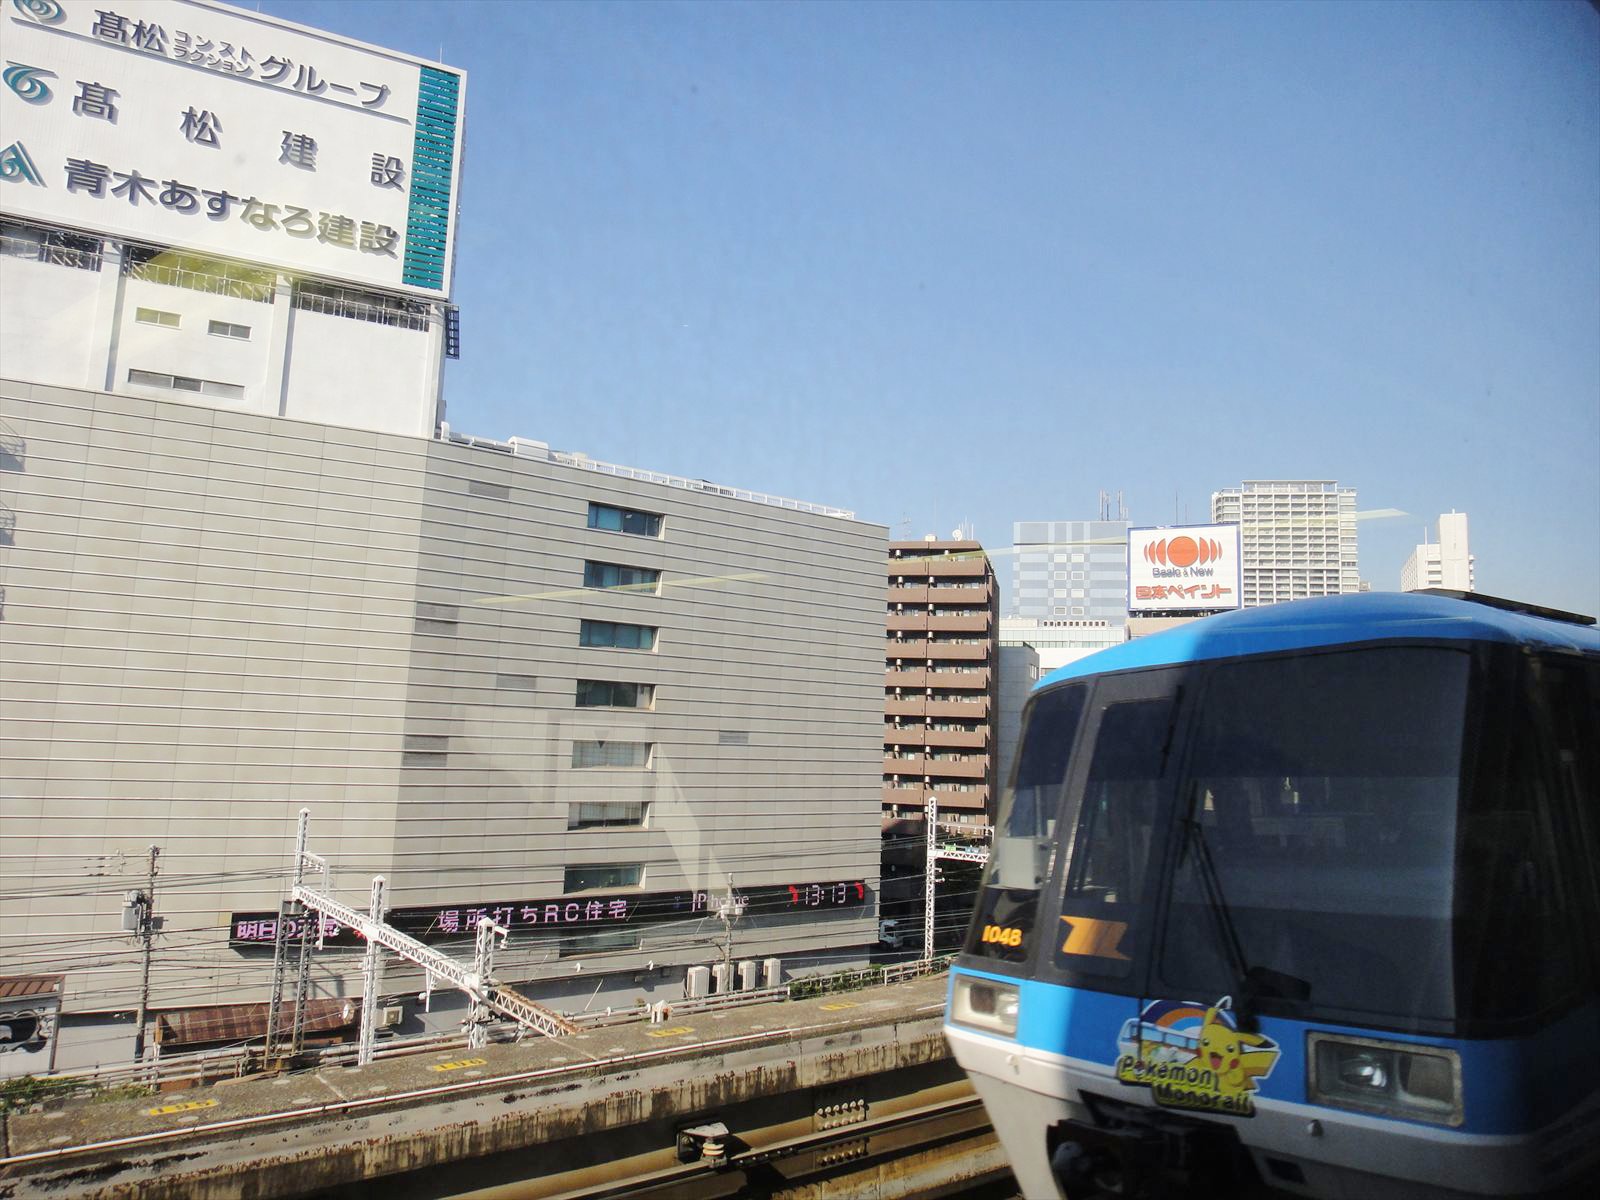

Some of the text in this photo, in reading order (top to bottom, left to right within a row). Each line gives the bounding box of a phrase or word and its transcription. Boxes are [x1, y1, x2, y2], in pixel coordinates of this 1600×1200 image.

[64, 156, 400, 258] 青木あすなろ建設
[1190, 566, 1214, 577] New
[1135, 584, 1232, 599] 日本ペイント
[805, 882, 847, 906] 13:13
[437, 899, 628, 934] 場所打ちRC住宅
[982, 925, 1023, 947] 1048
